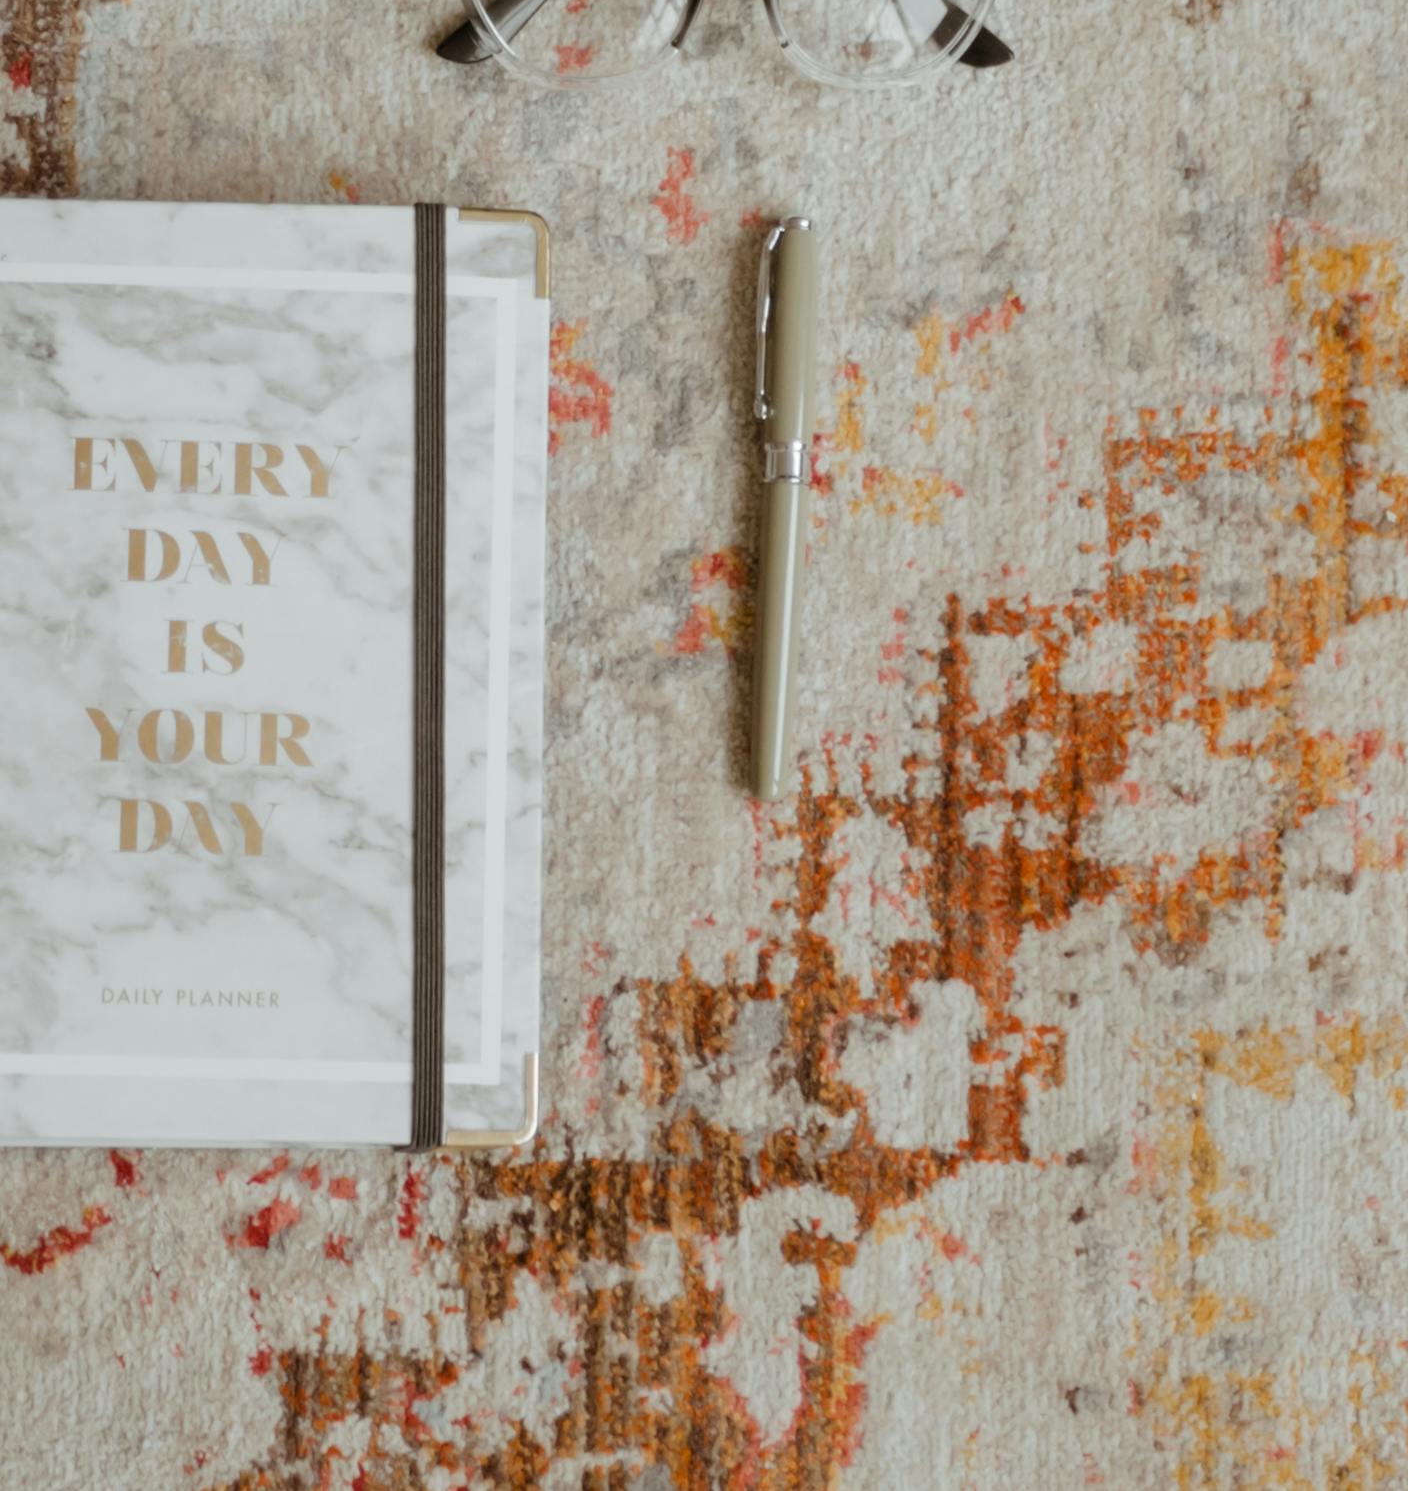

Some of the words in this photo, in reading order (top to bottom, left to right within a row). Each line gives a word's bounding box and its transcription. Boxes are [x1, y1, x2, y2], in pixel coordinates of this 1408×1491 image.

[67, 436, 345, 499] EVERY
[121, 527, 287, 586] DAY
[161, 619, 245, 676] IS
[85, 707, 315, 767] YOUR
[113, 798, 282, 857] DAY
[101, 987, 164, 1005] DAILY
[176, 989, 280, 1008] PLANNER
